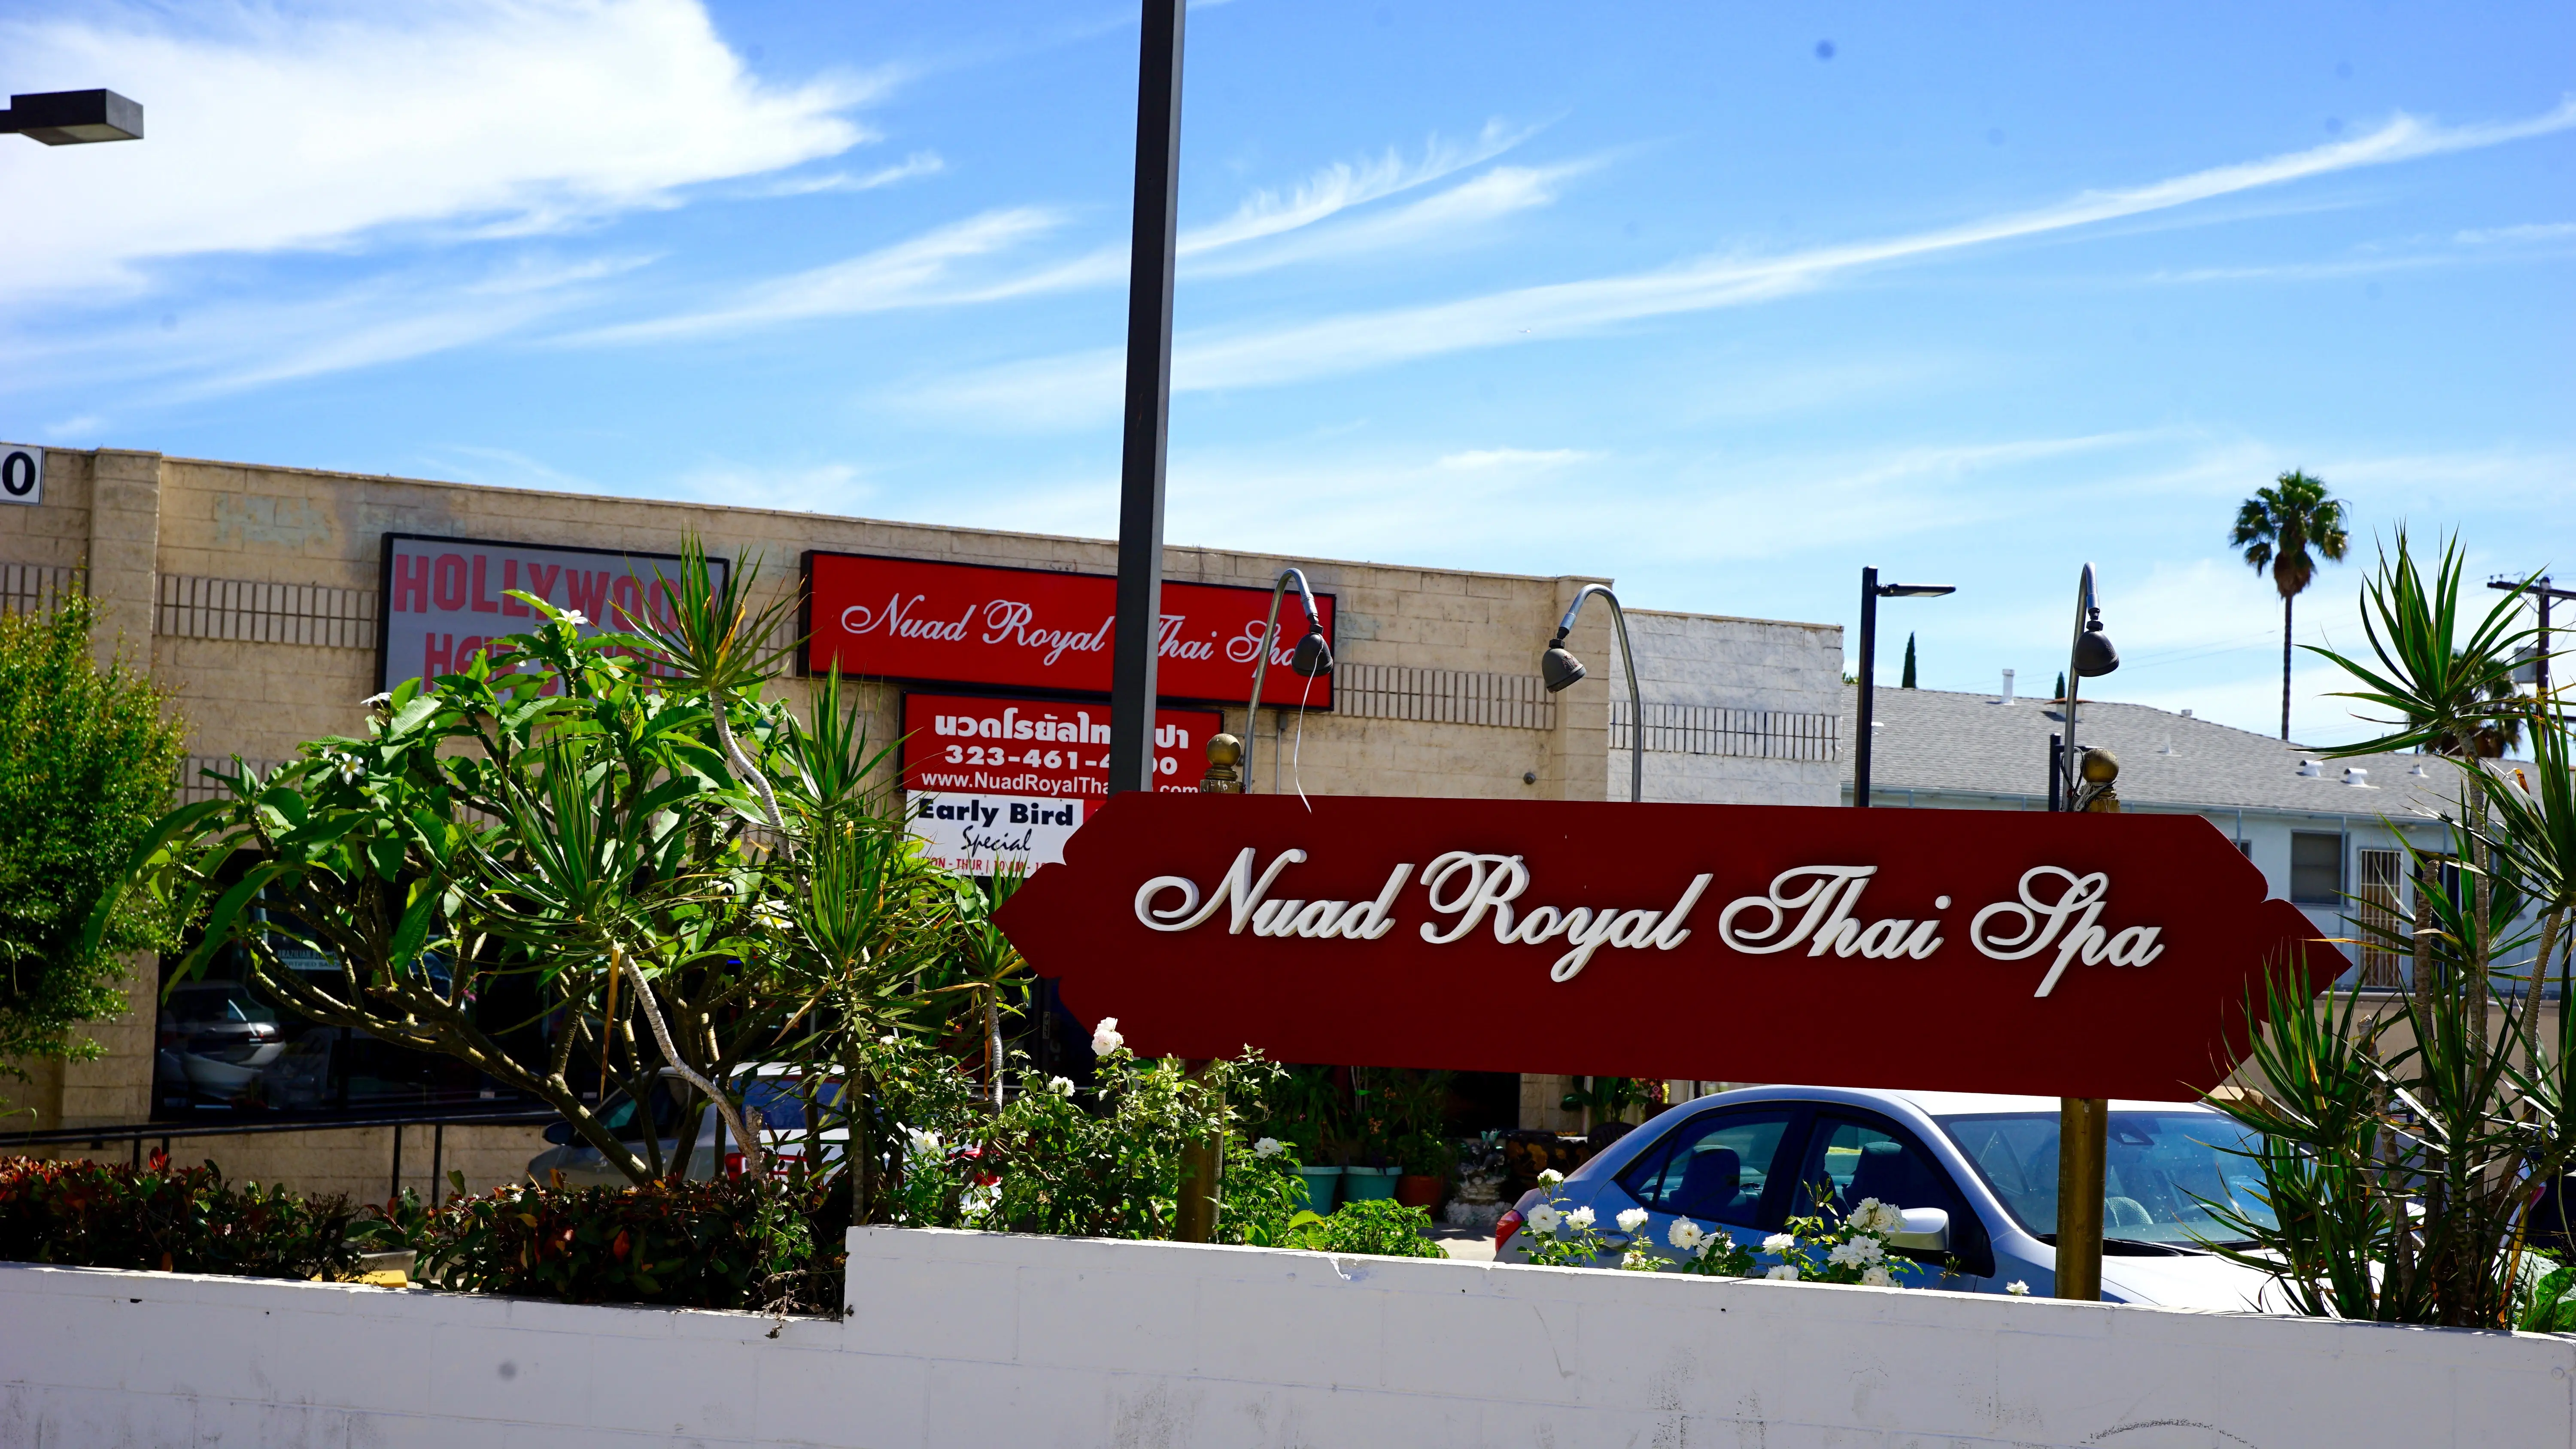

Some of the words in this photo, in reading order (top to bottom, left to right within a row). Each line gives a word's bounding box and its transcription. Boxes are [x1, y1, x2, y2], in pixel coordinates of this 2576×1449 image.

[841, 593, 976, 641] Nuad
[982, 599, 1115, 666] Royal
[918, 798, 999, 828] Early
[1010, 803, 1073, 826] Bird
[961, 825, 1032, 858] Special
[922, 856, 945, 868] ON
[956, 858, 982, 870] THUR
[1135, 847, 1415, 939] Nuad
[1420, 851, 1713, 982] Royal
[1719, 865, 1951, 960] Thai
[1970, 865, 2165, 997] Spa
